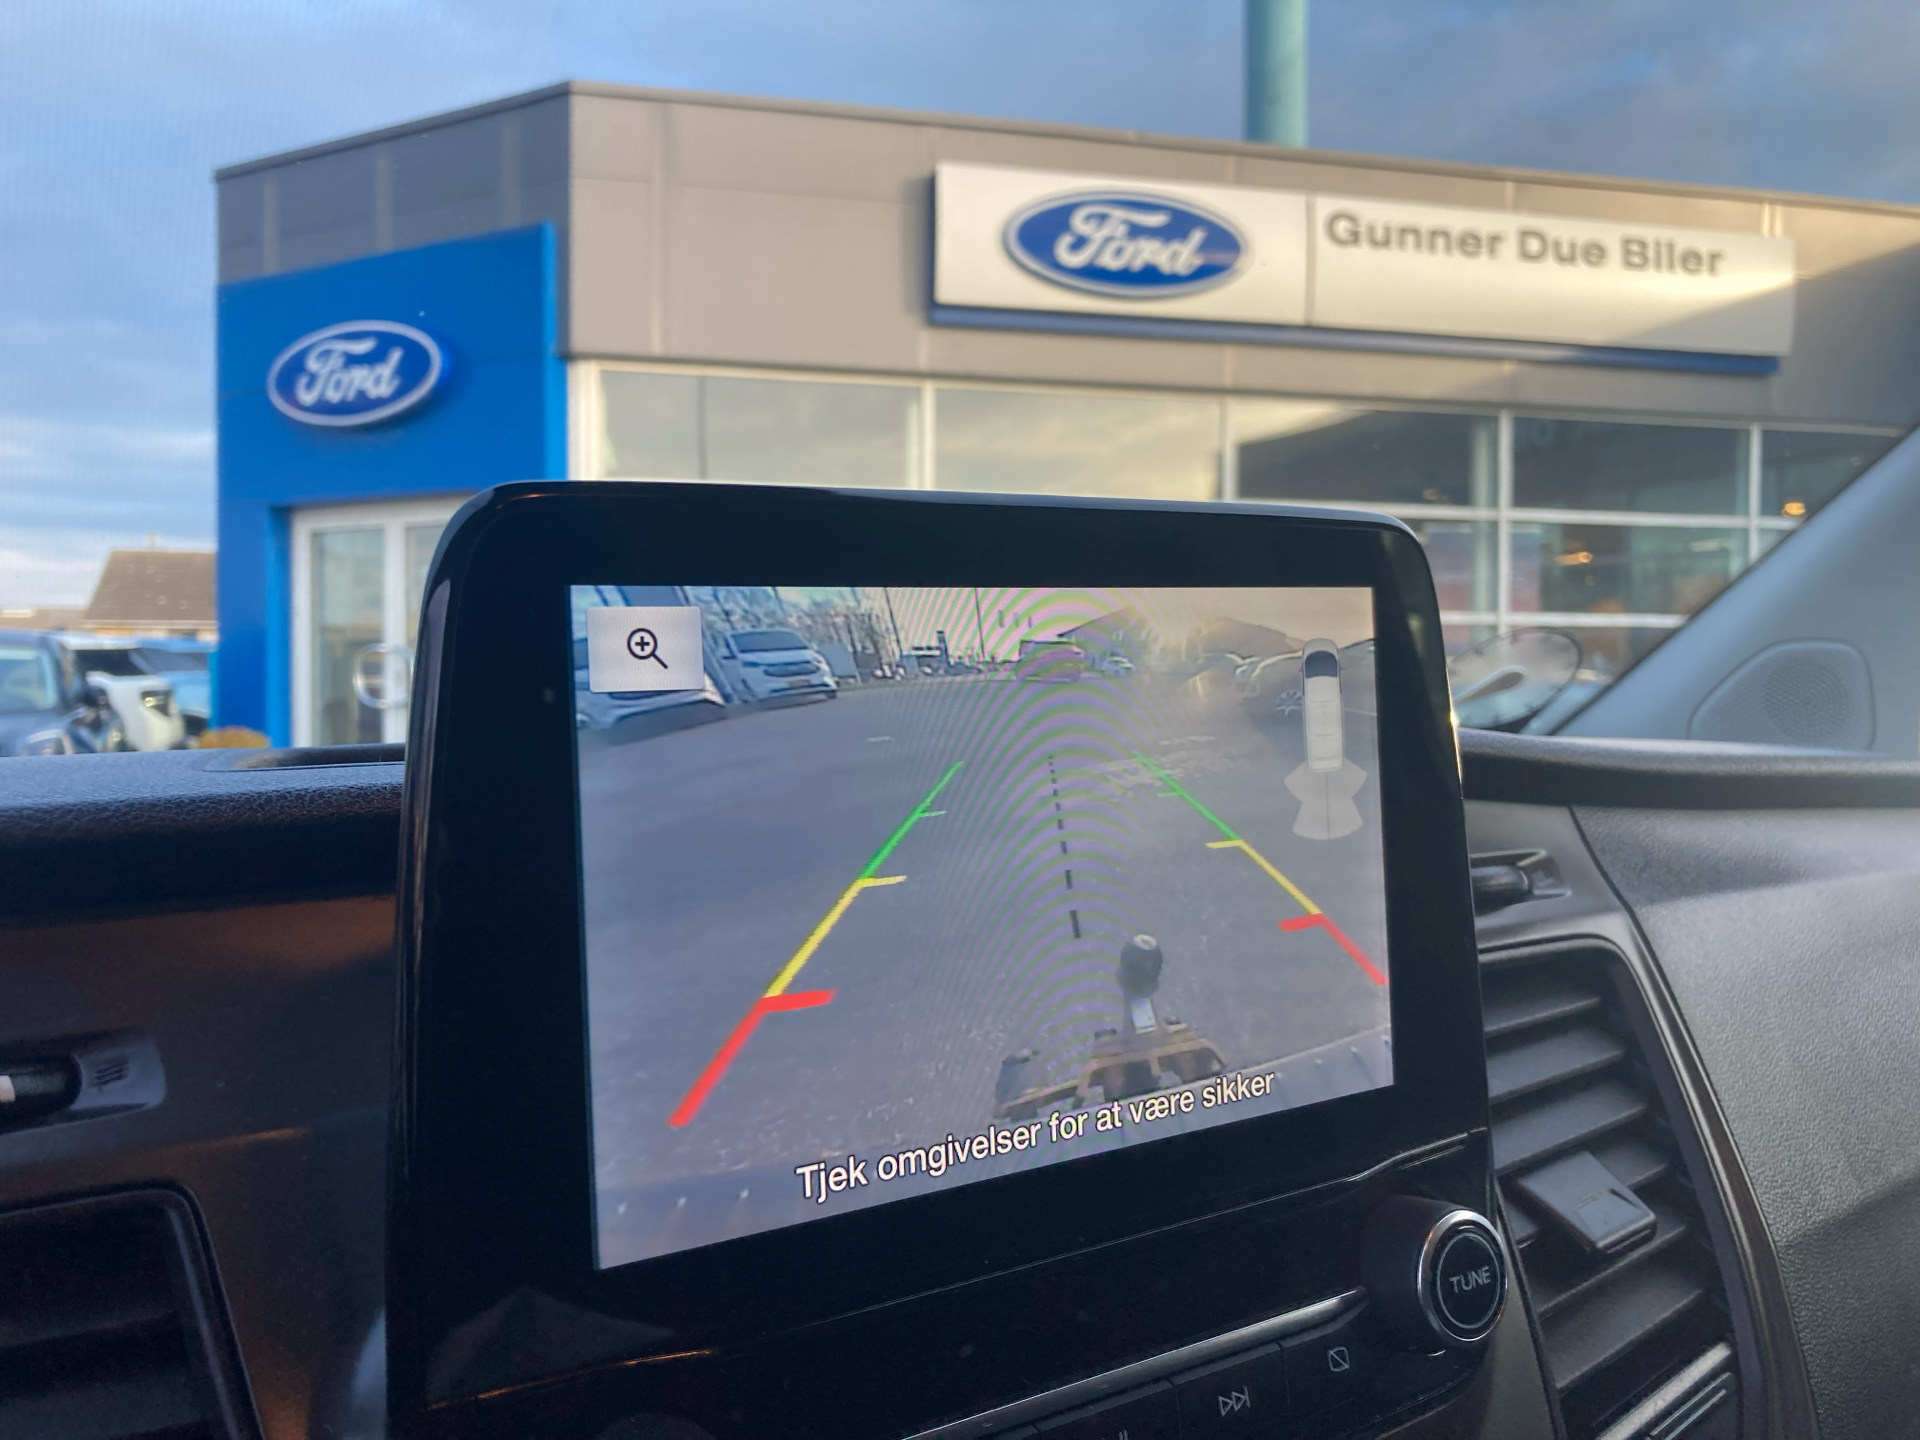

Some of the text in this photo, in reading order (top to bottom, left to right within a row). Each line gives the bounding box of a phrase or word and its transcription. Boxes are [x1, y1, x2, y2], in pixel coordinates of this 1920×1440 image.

[1054, 203, 1207, 276] Ford
[1326, 211, 1724, 277] Gunner Due Biler
[295, 336, 404, 407] Ford
[796, 1068, 1276, 1203] Tjek omgivelser for at være sikker
[1449, 1265, 1492, 1294] TUNE
